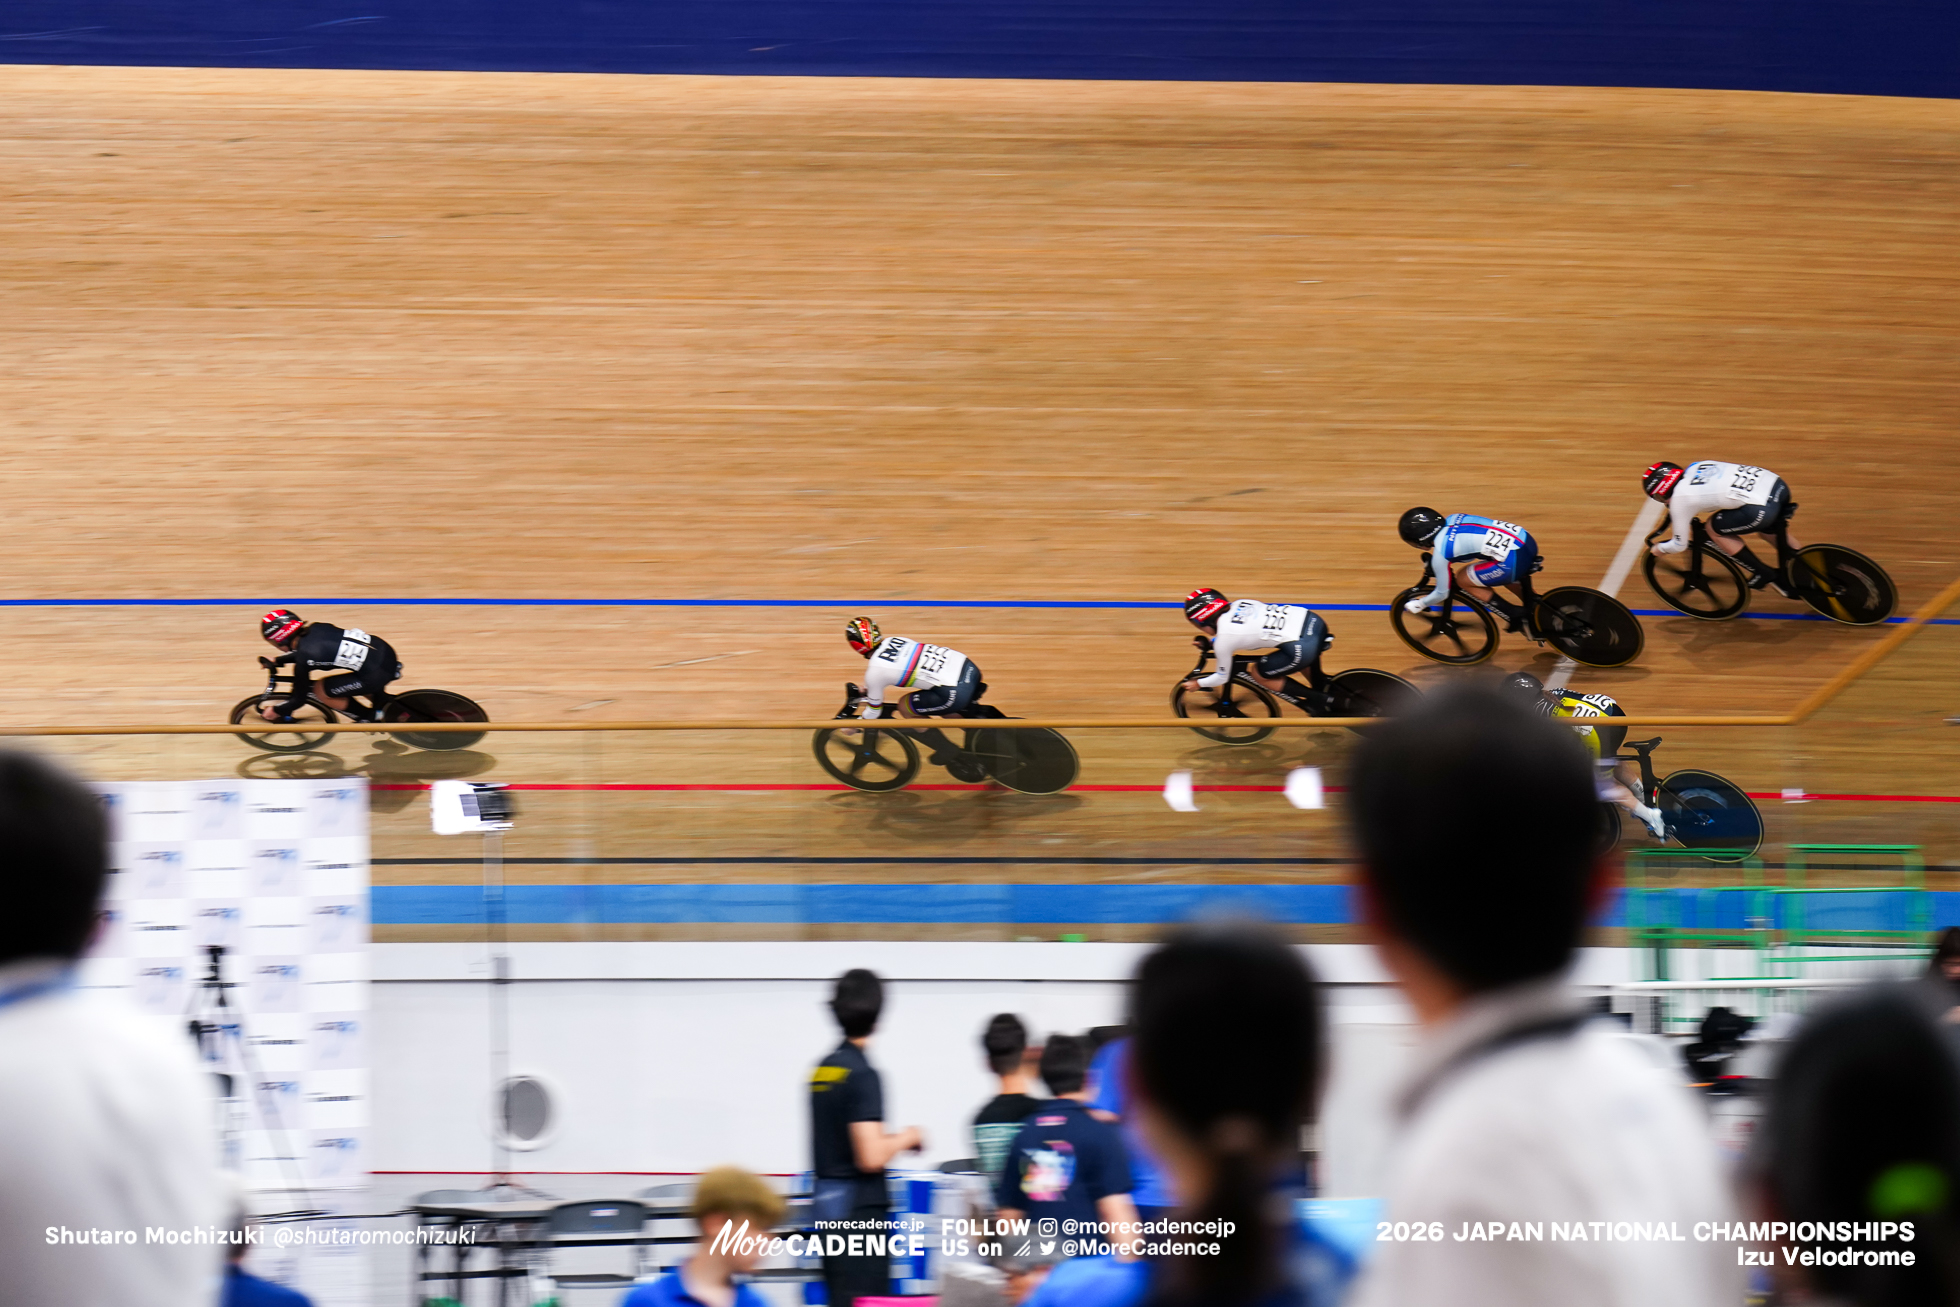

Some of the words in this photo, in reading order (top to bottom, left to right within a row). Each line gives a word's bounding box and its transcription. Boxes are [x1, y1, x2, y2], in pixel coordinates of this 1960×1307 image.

[1730, 473, 1756, 493] 228
[1485, 530, 1511, 552] 224
[1262, 613, 1286, 631] 220
[920, 654, 945, 673] 223
